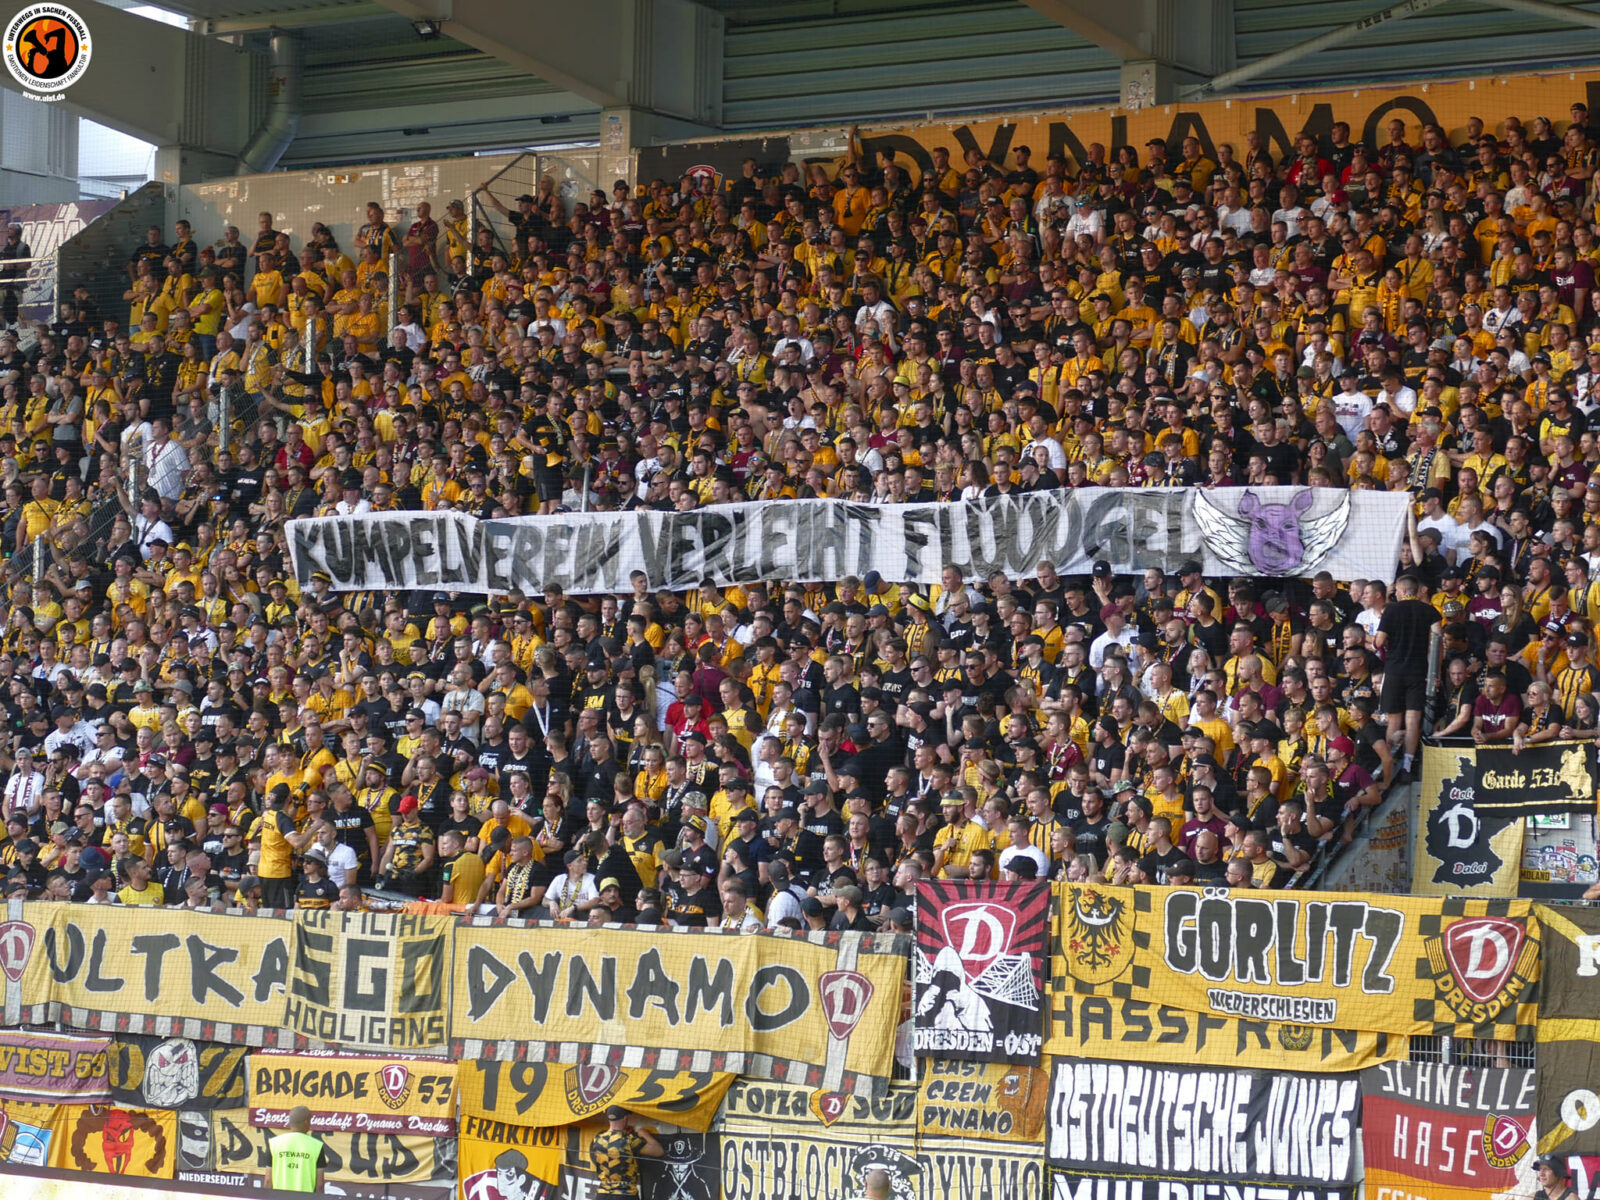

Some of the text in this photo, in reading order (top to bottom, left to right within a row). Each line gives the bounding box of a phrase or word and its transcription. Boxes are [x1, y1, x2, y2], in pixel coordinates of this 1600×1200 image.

[1482, 769, 1526, 789] Garde
[1453, 862, 1488, 875] Dabei
[1164, 887, 1405, 994] GÖRLITZ
[466, 944, 811, 1033] DYNAMO
[1436, 973, 1526, 1024] DRESDEN
[1209, 990, 1335, 1023] NIEDERSCHLESIEN
[283, 998, 445, 1047] HOOLIGANS
[914, 1029, 995, 1052] DRESDEN
[75, 1051, 108, 1079] 53
[256, 1067, 454, 1106] BRIGADE 53
[379, 1088, 410, 1110] DRESDEN
[926, 1080, 993, 1104] CREW
[1379, 1060, 1536, 1112] SCHNELLE
[567, 1091, 612, 1116] DRESDEN
[356, 1112, 404, 1130] Dynamo
[407, 1115, 450, 1134] Dresden
[922, 1105, 1013, 1135] DYNAMO
[1050, 1063, 1359, 1182] OSTDEUTSCHE JUNGS
[279, 1151, 310, 1160] STEWARD
[1393, 1113, 1483, 1177] HASE
[1484, 1134, 1519, 1168] DRESDEN
[179, 1171, 246, 1186] NIEDERSEDLITZ
[723, 1139, 1043, 1200] OSTBLOCK DYNAMO
